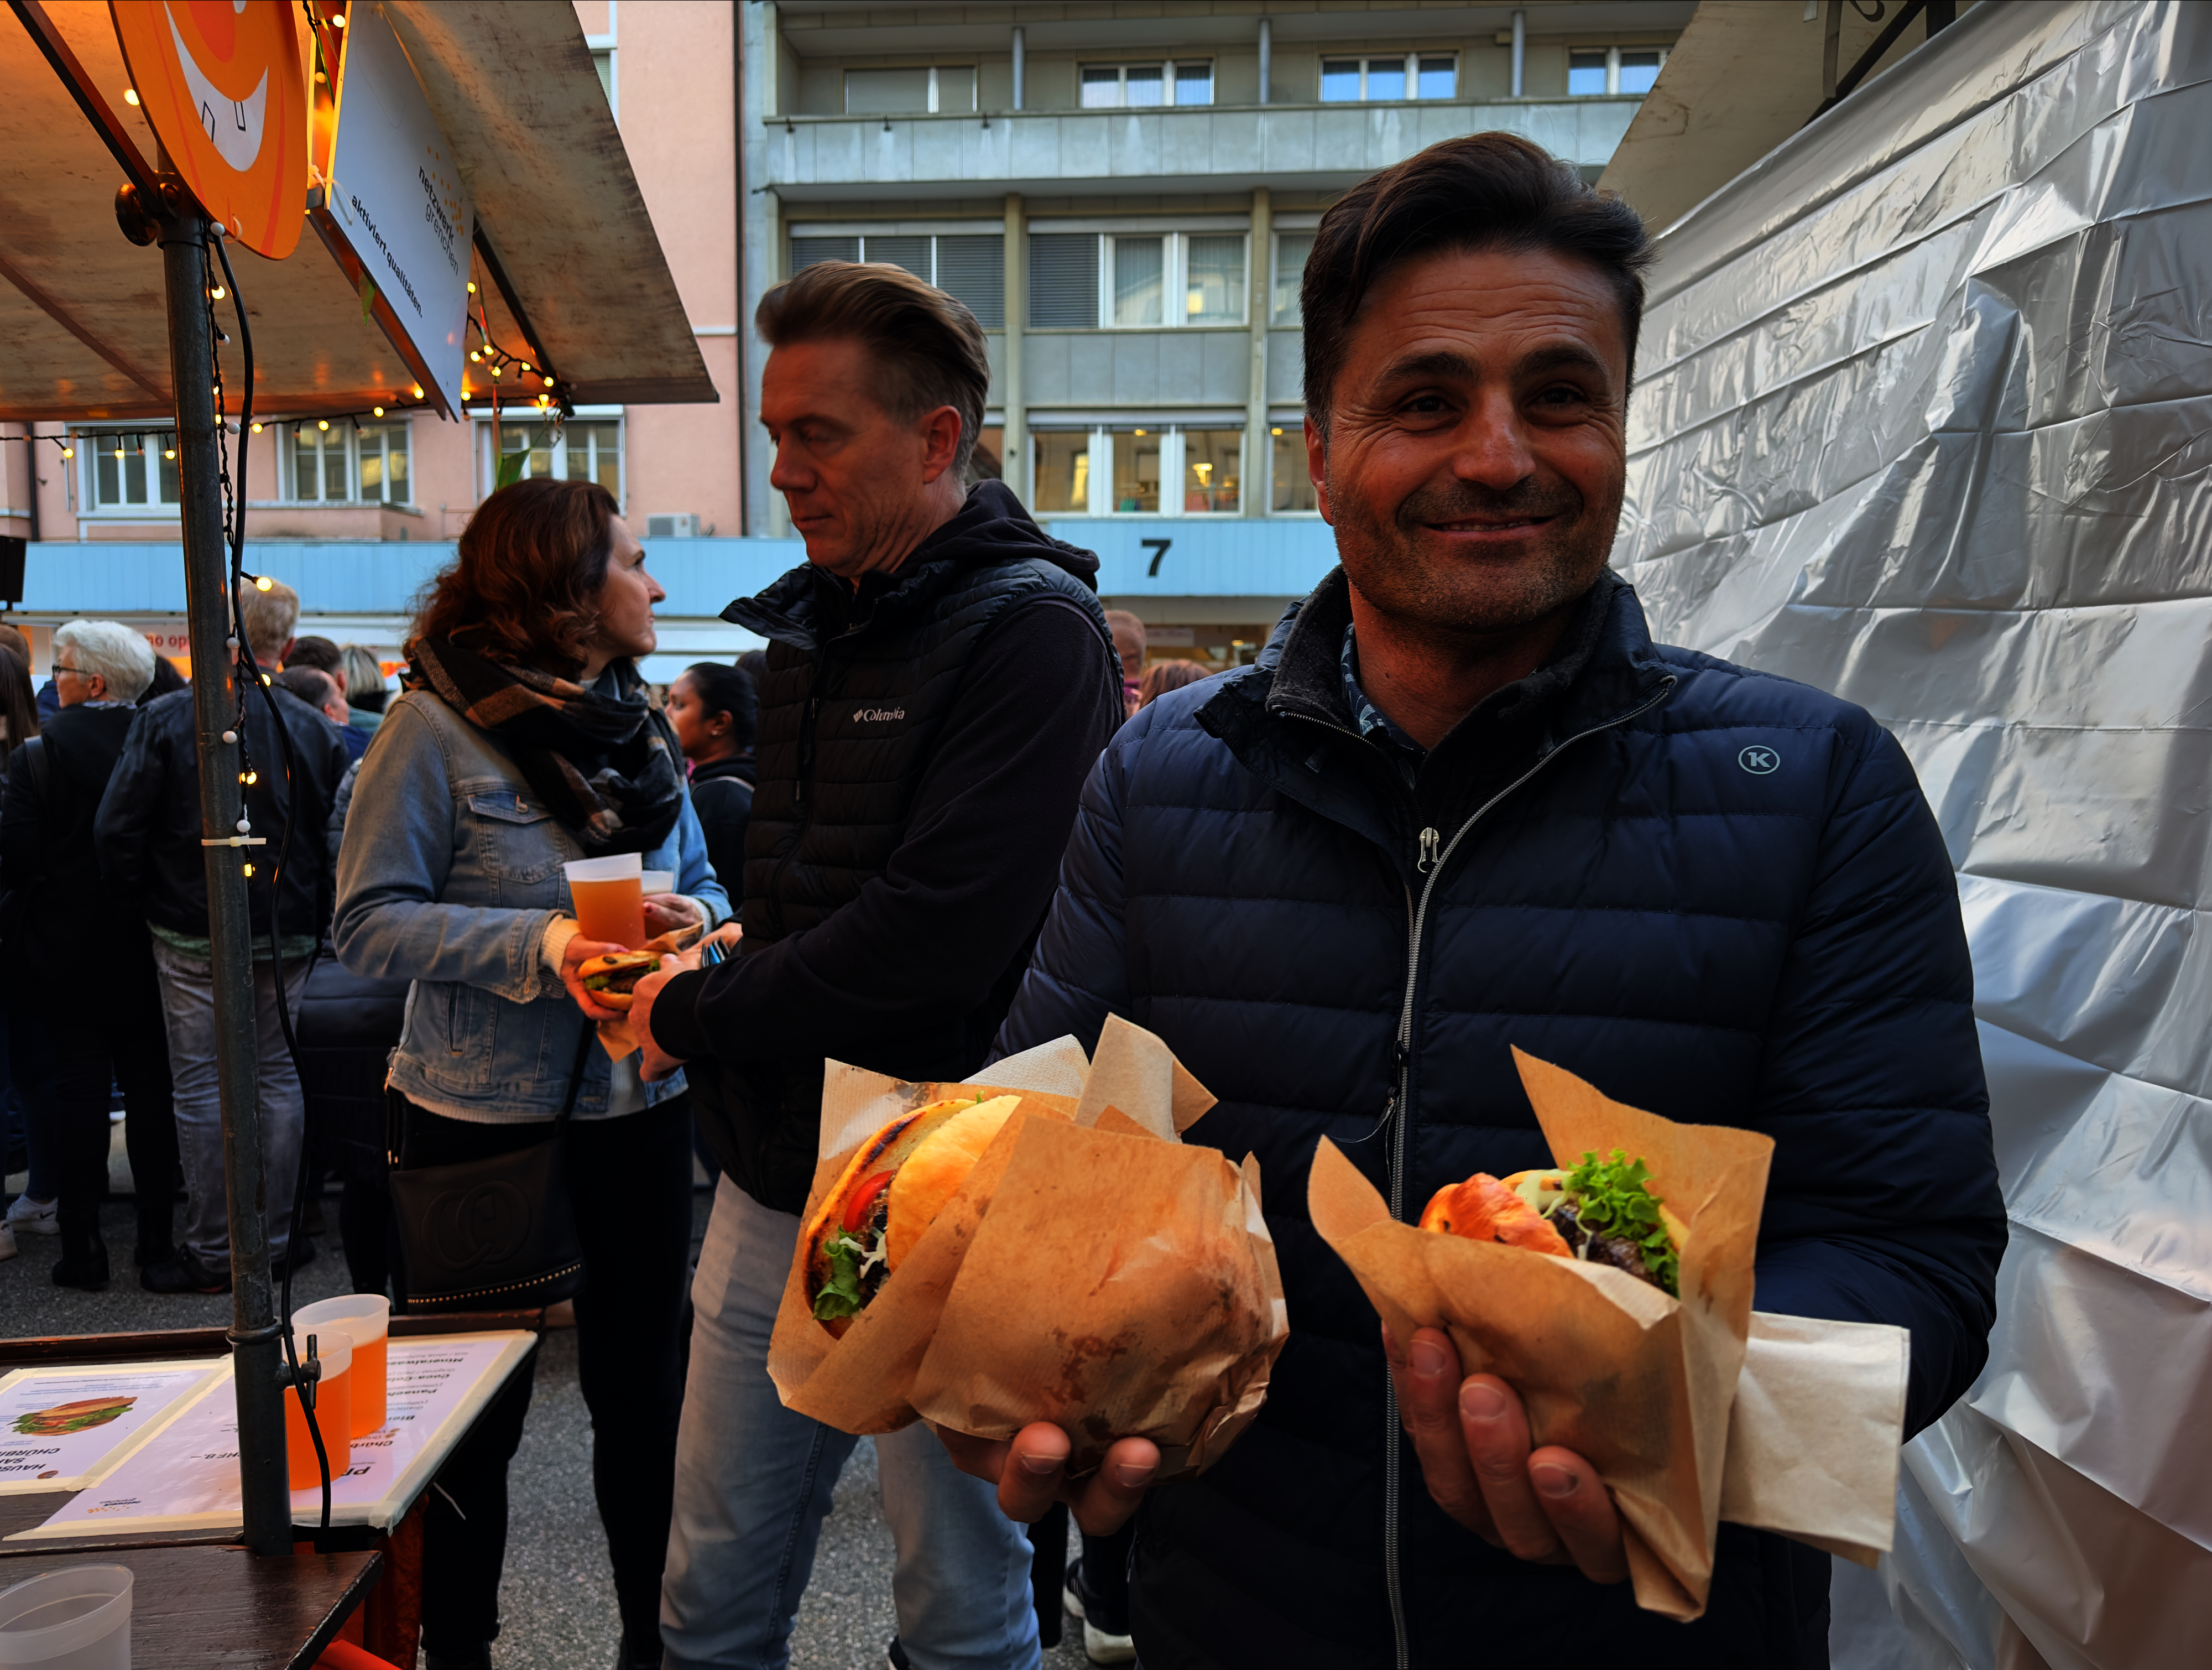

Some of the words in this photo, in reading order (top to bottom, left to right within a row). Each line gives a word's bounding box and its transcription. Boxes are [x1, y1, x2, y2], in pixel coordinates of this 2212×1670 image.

[419, 165, 454, 245] netzwerk
[425, 203, 459, 276] grenchen
[352, 195, 387, 255] aktiviert
[387, 251, 422, 318] qualitäten.
[1141, 538, 1173, 577] 7
[168, 634, 189, 652] op
